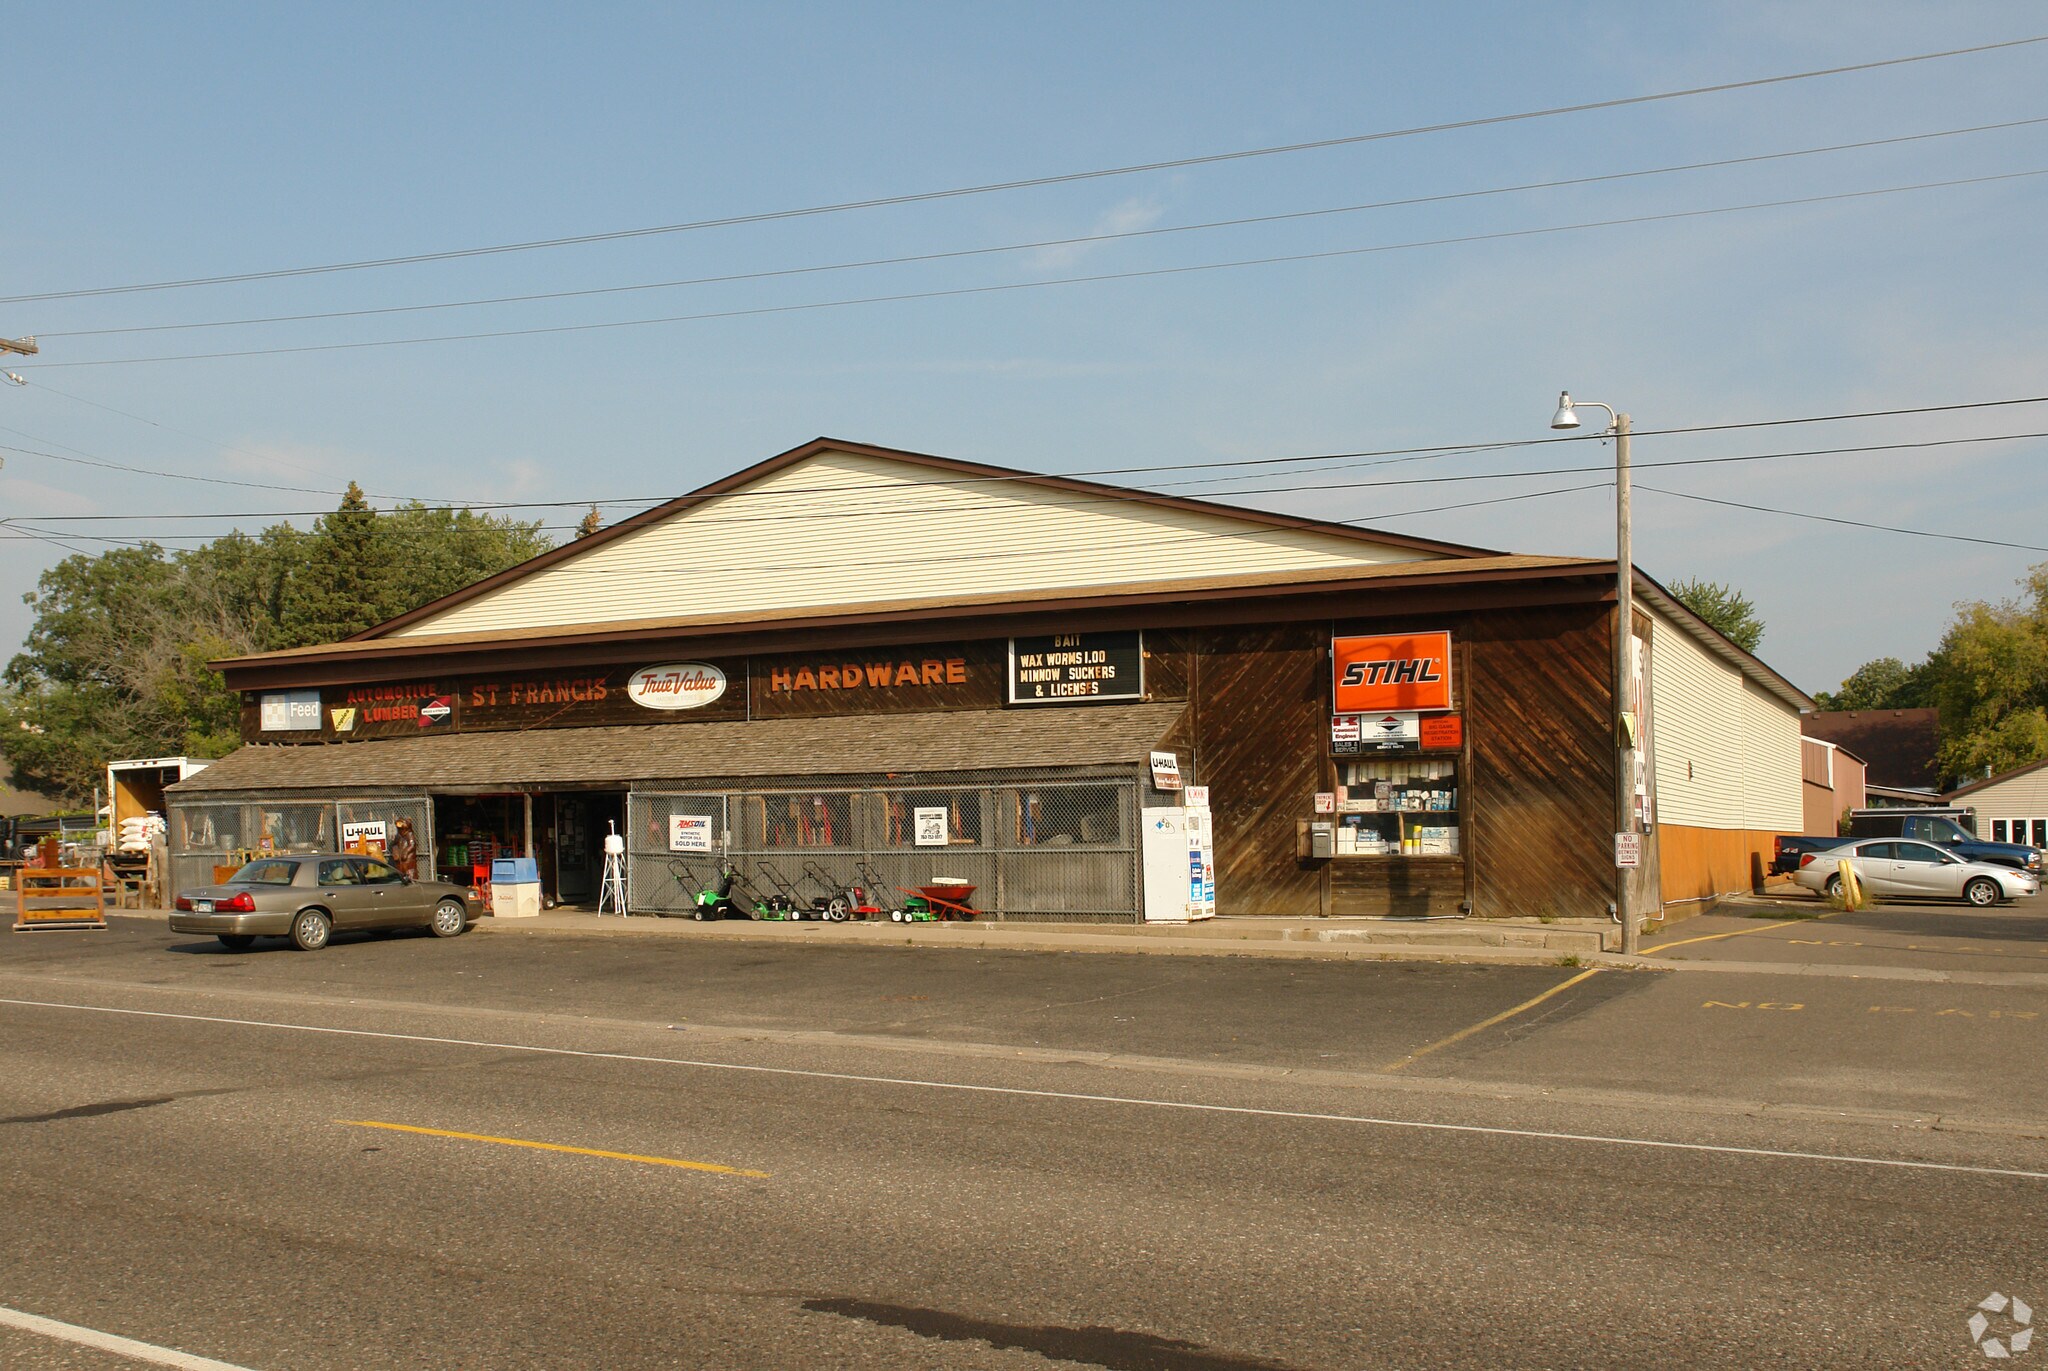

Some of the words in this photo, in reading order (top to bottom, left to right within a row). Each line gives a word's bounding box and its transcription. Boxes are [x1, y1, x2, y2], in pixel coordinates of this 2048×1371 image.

[1054, 634, 1081, 648] BAIT
[1020, 653, 1043, 668] WAX
[1046, 651, 1082, 666] WORMS
[1084, 650, 1106, 664] 1.00
[771, 658, 967, 692] HARDWARE
[1020, 667, 1060, 683] MINNOW
[1068, 665, 1116, 680] SUCKERS
[1340, 657, 1441, 687] STIHL
[347, 683, 437, 704] AUTOMOTIVE
[472, 683, 500, 707] ST
[511, 678, 608, 705] FRANCIS
[1035, 684, 1044, 697] &
[1050, 681, 1099, 697] LICENSES
[290, 701, 319, 718] Feed
[363, 704, 418, 723] LUMBER
[1152, 757, 1176, 769] U-HAUL
[346, 826, 383, 837] U-HAUL
[677, 820, 706, 828] AMSOIL
[1702, 1000, 1805, 1011] NO
